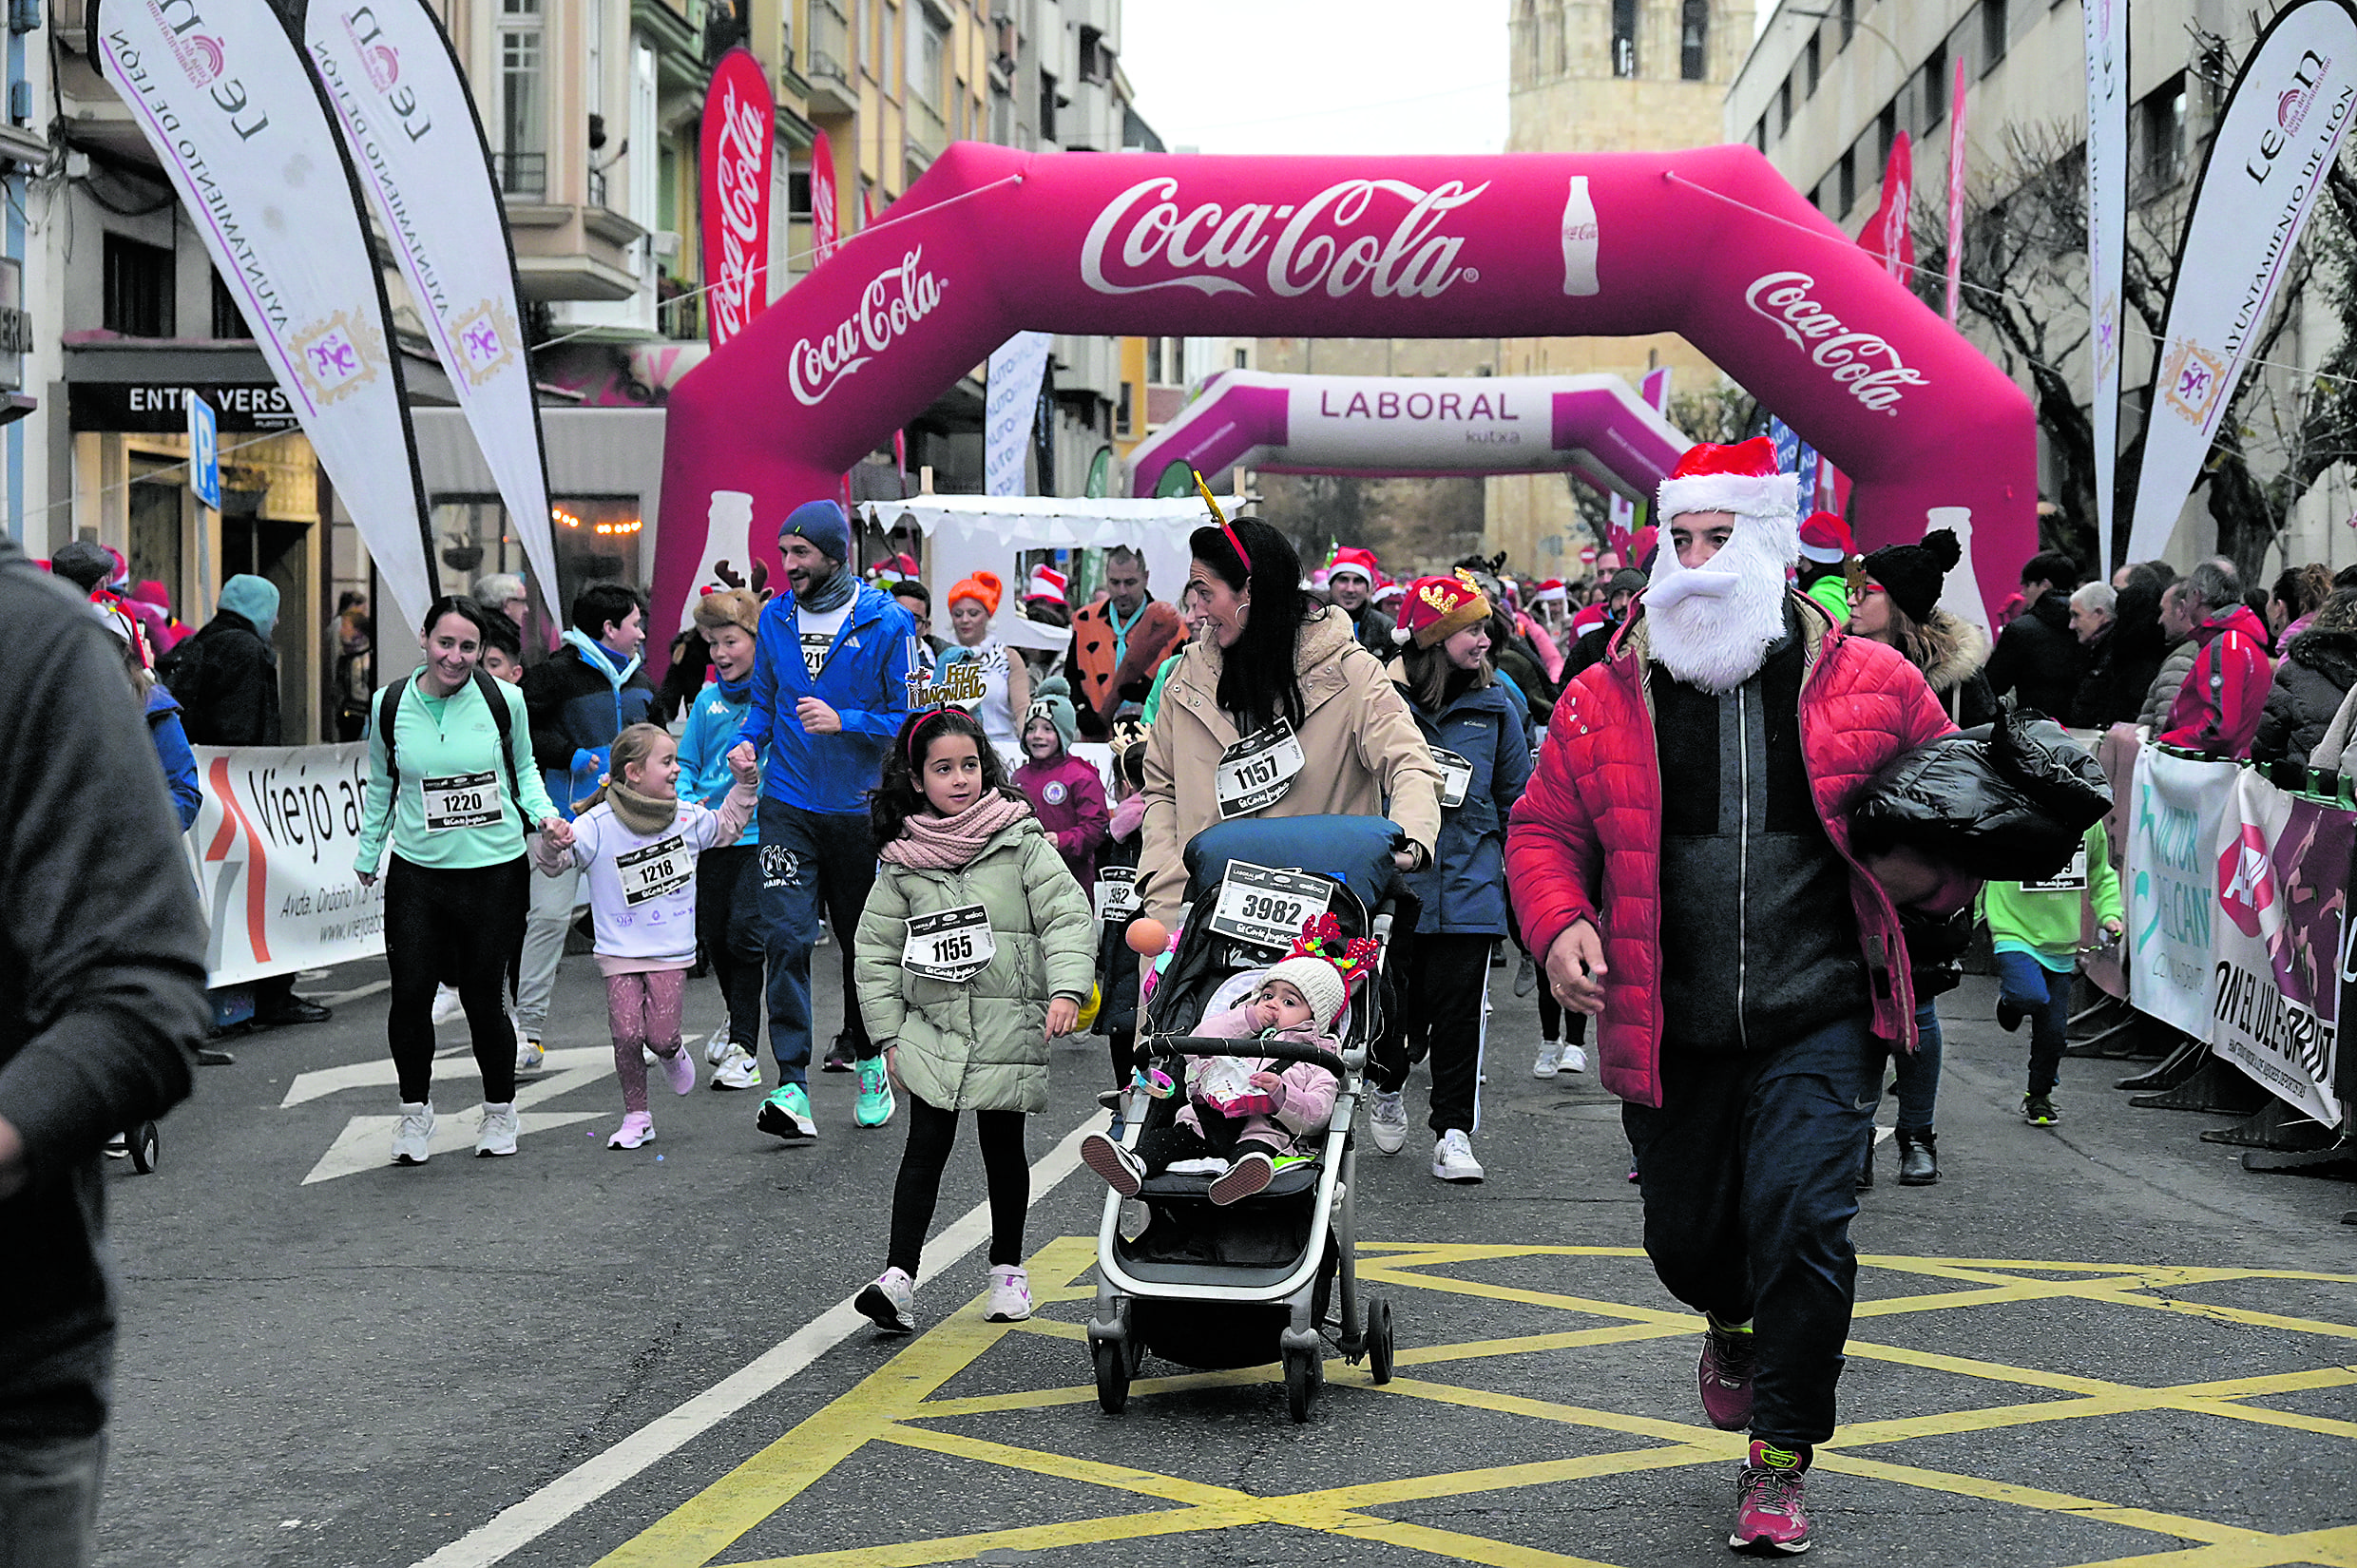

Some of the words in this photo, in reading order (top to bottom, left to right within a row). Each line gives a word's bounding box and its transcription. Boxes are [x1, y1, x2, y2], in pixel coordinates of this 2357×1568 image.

[1081, 177, 1491, 297] Coca-Cola
[2225, 184, 2304, 358] AYUNTAMIENTO
[2302, 148, 2322, 177] DE
[2319, 85, 2354, 143] LEÓN
[789, 243, 941, 406] Coca-Cola
[1746, 271, 1930, 411] Coca-Cola
[1321, 390, 1520, 420] LABORAL
[197, 410, 214, 489] P
[1466, 430, 1521, 444] kutxa
[947, 665, 980, 684] FELIZ
[1234, 755, 1278, 790] 1157
[248, 765, 333, 864] Viejo
[443, 793, 482, 813] 1220
[639, 859, 674, 884] 1218
[280, 889, 312, 919] Avda.
[1242, 894, 1302, 926] 3982
[932, 935, 972, 963] 1155
